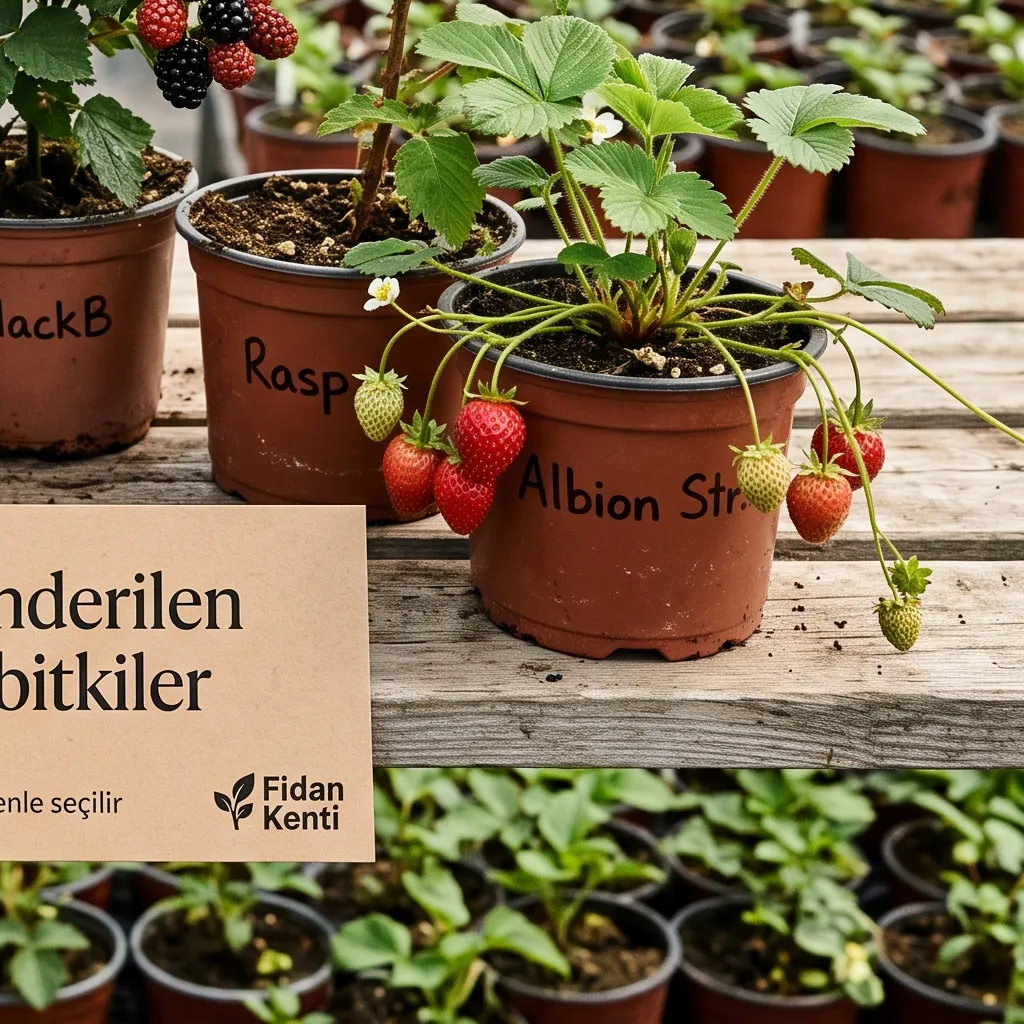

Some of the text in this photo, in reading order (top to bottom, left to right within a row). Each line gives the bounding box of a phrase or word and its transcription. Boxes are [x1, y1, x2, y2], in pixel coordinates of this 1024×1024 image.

[244, 336, 350, 415] Rasp
[518, 453, 660, 522] Albion
[263, 774, 344, 802] Fidan
[50, 790, 123, 820] seçilir
[263, 804, 339, 832] Kenti
